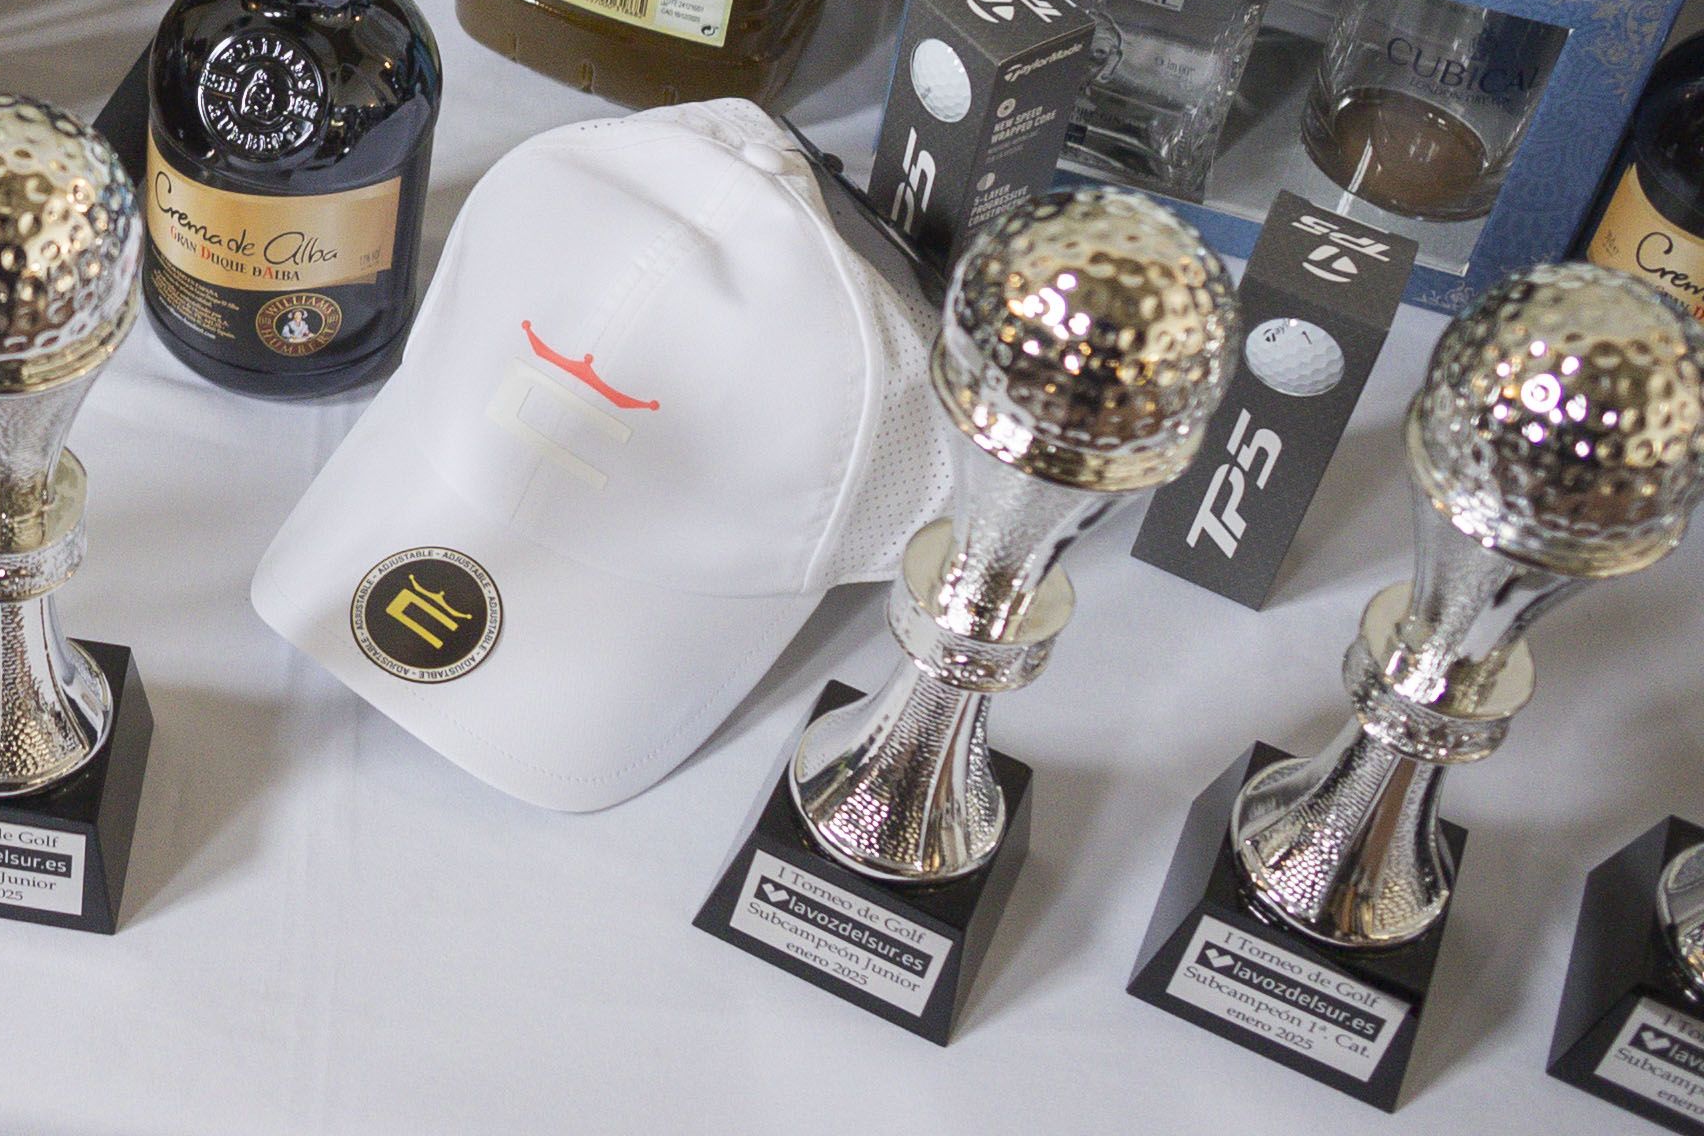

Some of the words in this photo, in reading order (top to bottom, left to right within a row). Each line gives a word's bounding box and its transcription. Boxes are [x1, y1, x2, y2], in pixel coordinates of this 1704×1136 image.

[890, 126, 937, 237] P5
[155, 171, 223, 247] Crema
[227, 229, 256, 257] de
[263, 231, 338, 266] Alba
[1291, 215, 1391, 262] TP5
[169, 225, 197, 252] GRAN
[200, 245, 247, 276] DUQUE
[1186, 408, 1283, 560] TP5
[377, 549, 434, 575] ADJUSTABLE
[442, 551, 491, 590] ADJUSTABLE
[356, 579, 374, 630] ADJUSTABLE
[480, 595, 499, 651] ADJUSTABLE
[360, 637, 411, 676] ADJUSTABLE
[418, 654, 478, 680] ADJUSTABLE
[18, 831, 60, 848] Golf
[777, 866, 785, 879] I
[792, 873, 853, 911] Torneo
[857, 904, 881, 923] de
[884, 917, 927, 945] Golf
[747, 902, 860, 965] Subcampeón
[863, 956, 921, 993] Junior
[788, 895, 924, 971] lavozdelsur.es
[786, 941, 829, 967] enero
[832, 963, 869, 986] 2025
[1224, 931, 1233, 945] I
[1239, 936, 1304, 975] Torneo
[1307, 970, 1331, 989] de
[1336, 981, 1382, 1009] Golf
[1183, 965, 1309, 1029] Subcampeón
[1335, 1033, 1371, 1059] Cat.
[1233, 960, 1376, 1035] lavozdelsur.es
[1226, 1006, 1272, 1032] enero
[1276, 1027, 1314, 1051] 2025
